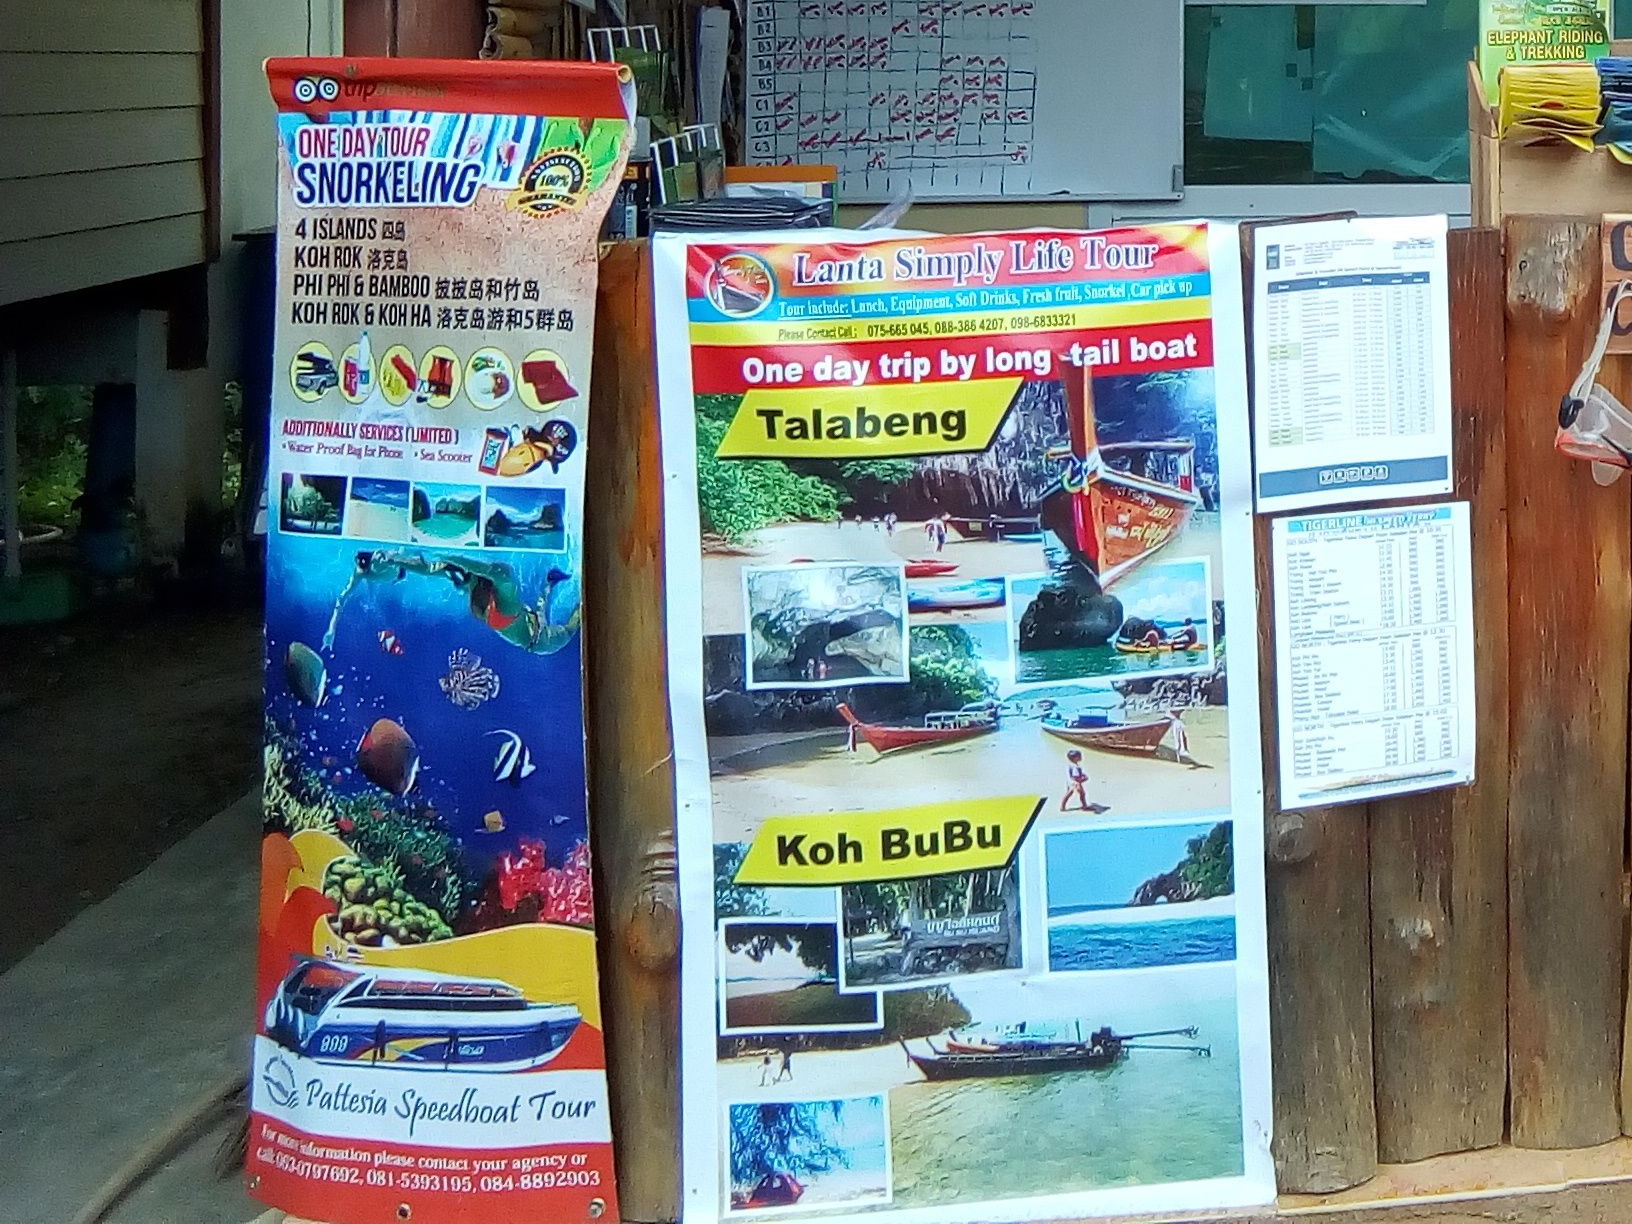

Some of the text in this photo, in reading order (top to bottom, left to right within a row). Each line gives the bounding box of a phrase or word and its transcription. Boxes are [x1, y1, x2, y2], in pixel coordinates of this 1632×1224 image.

[1487, 29, 1604, 46] ELEPHANT RIDING
[1520, 45, 1586, 60] TREKKING
[300, 127, 430, 159] ONE DAY TOUR
[296, 162, 482, 205] SNORKELING
[294, 218, 377, 241] 4 ISLANDS
[294, 245, 362, 270] KOH ROK
[792, 235, 1160, 288] Lanta Simply Life Tour
[293, 274, 324, 297] PHI
[327, 275, 351, 297] PHI
[368, 276, 431, 299] BAMBOO
[291, 302, 329, 325] KOH
[332, 303, 360, 325] ROK
[378, 304, 409, 327] KOH
[410, 305, 432, 326] HA
[778, 300, 806, 318] Tour
[742, 356, 805, 384] One
[813, 353, 871, 387] day
[879, 351, 931, 386] trip
[940, 345, 977, 381] by
[986, 343, 1052, 381] long
[1130, 332, 1199, 362] boat
[756, 406, 968, 443] Talabeng
[776, 819, 1002, 867] Koh BuBu
[393, 1087, 523, 1138] Speedboat
[528, 1090, 598, 1123] Tour
[373, 1150, 416, 1170] please
[417, 1155, 470, 1172] contact
[471, 1156, 507, 1177] your
[511, 1154, 568, 1176] agency
[570, 1152, 588, 1167] or
